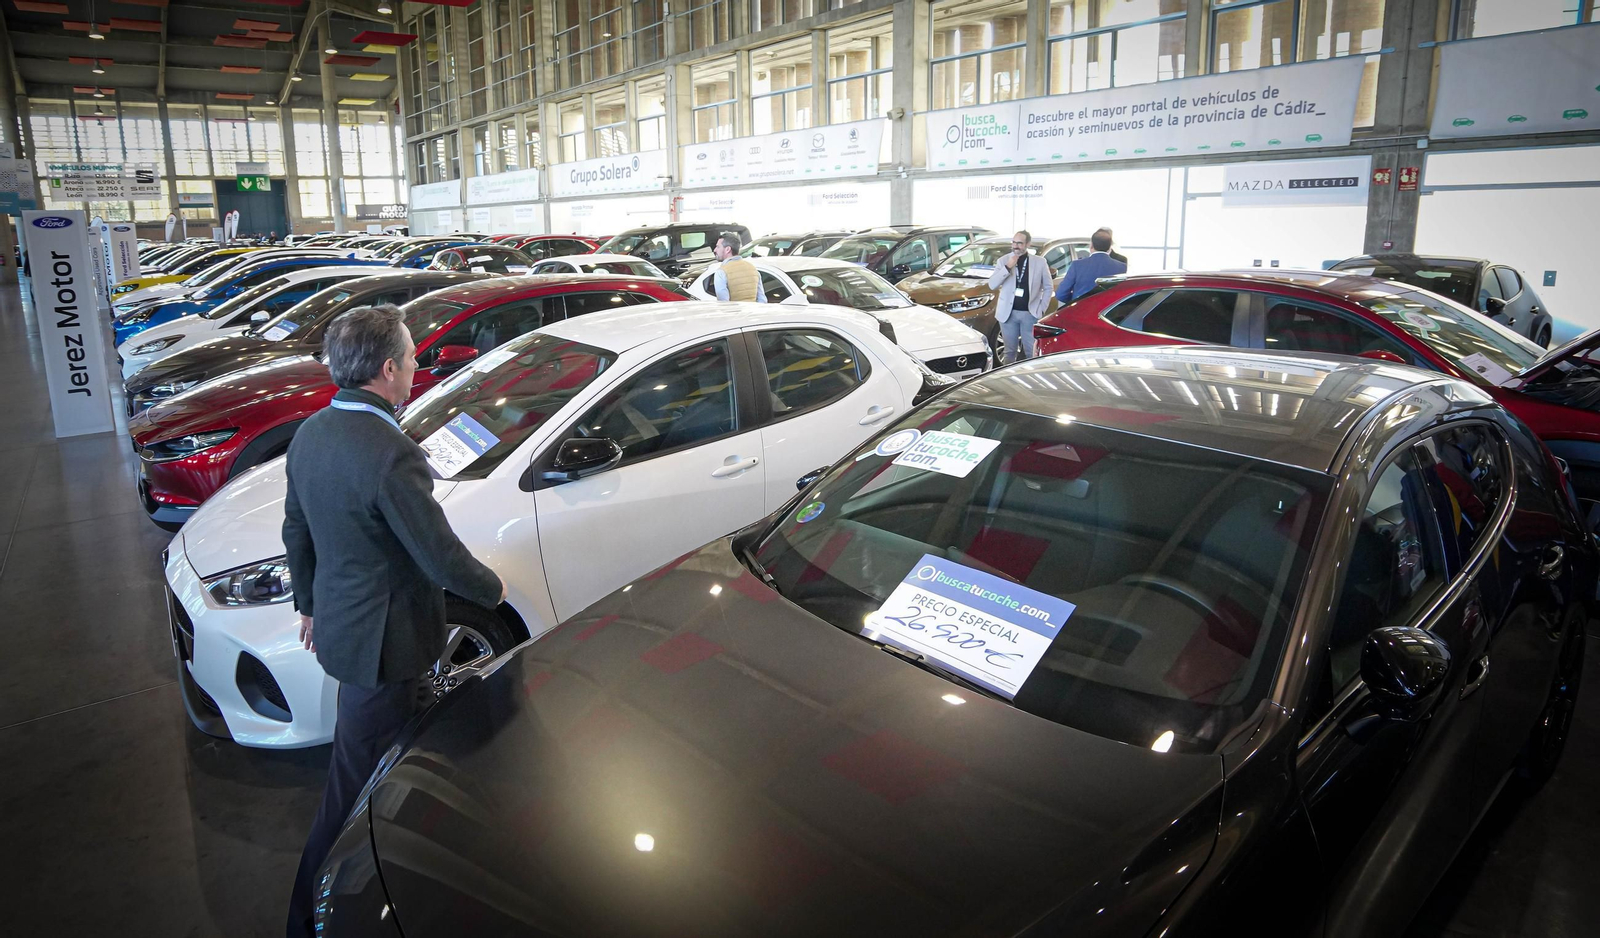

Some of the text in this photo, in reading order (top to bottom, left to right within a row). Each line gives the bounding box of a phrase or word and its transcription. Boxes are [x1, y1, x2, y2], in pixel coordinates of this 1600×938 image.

[1028, 86, 1279, 125] Descubre el mayor portal de vehículos de
[965, 114, 995, 126] busca
[1026, 126, 1064, 139] ocasión
[1068, 125, 1075, 137] y
[1078, 119, 1144, 134] seminuevos
[1149, 116, 1163, 128] de
[1168, 114, 1179, 126] la
[1184, 108, 1245, 127] provincia
[1251, 105, 1268, 118] de
[965, 123, 1011, 137] tucoche.
[570, 163, 631, 186] Grupo Solera
[990, 183, 1043, 192] Ford Selección
[1228, 179, 1355, 191] MAZDA SELECTED
[39, 217, 65, 228] Ford
[50, 250, 91, 396] Jerez Motor
[925, 433, 970, 448] busca
[914, 442, 979, 463] tucoche.
[912, 594, 1020, 644] PRECIO ESPECIAL
